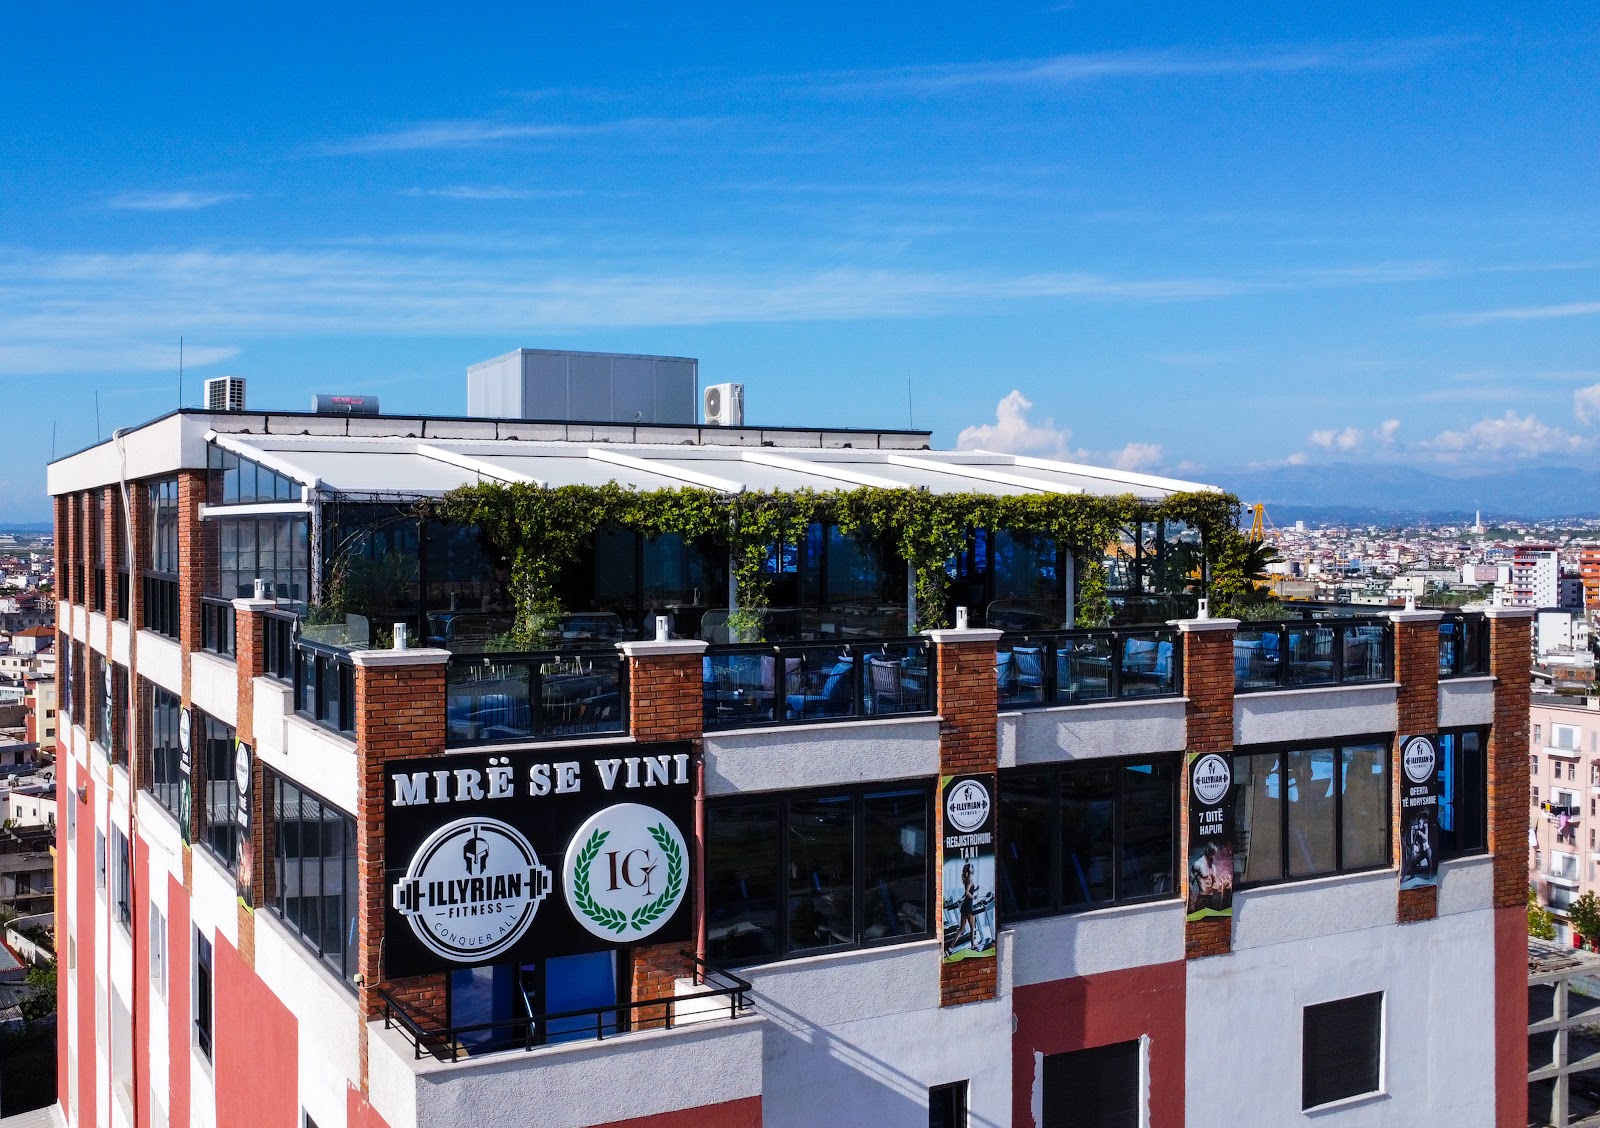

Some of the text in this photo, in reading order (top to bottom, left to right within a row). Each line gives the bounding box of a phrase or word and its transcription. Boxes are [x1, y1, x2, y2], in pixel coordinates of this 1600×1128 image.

[392, 753, 690, 807] MIRË SE VINI
[1201, 774, 1223, 785] ILLYRIAN
[1409, 785, 1429, 797] OFERTA
[956, 801, 981, 811] ILLYRIAN
[1402, 796, 1410, 808] TË
[1199, 808, 1224, 824] 7 DITË
[1199, 823, 1223, 835] HAPUR
[946, 832, 991, 848] REGJISTROHUNI
[960, 846, 979, 859] TANI
[428, 872, 522, 908] ILLYRIAN
[448, 902, 503, 919] FITNESS
[434, 913, 518, 947] CONQUER ALL
